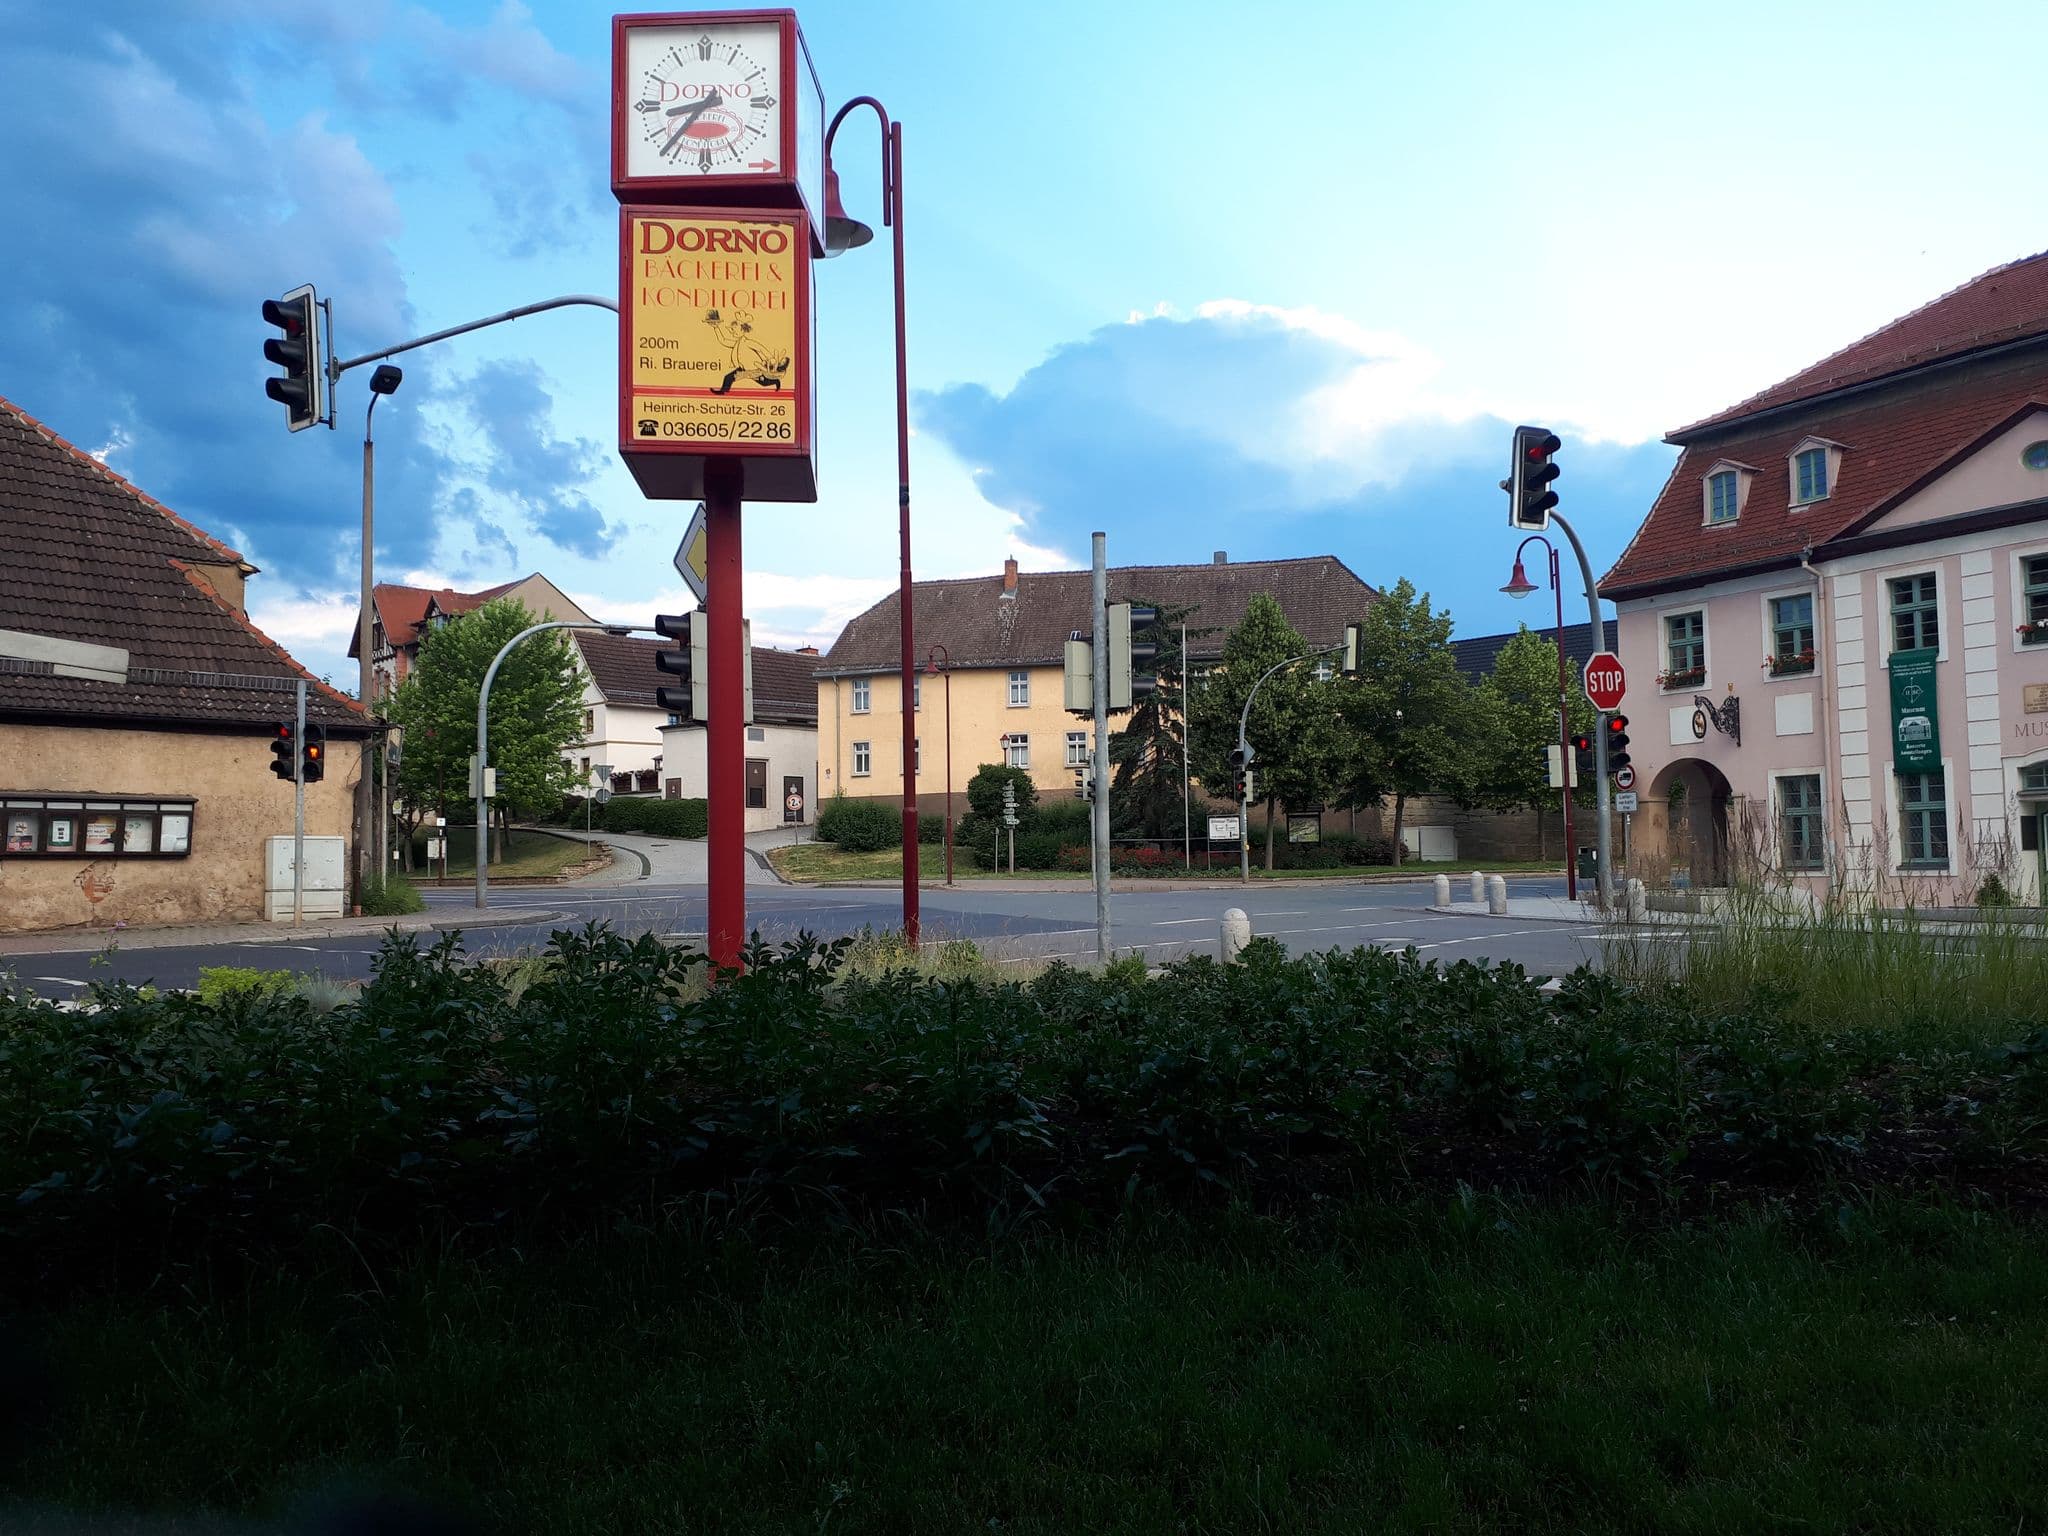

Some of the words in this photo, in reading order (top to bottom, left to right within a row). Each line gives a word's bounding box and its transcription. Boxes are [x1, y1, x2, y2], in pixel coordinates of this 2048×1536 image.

[640, 221, 788, 255] DORNO
[645, 255, 760, 281] BÄCKEREI
[766, 262, 782, 281] &
[642, 287, 786, 310] KONDITOREI
[639, 336, 680, 350] 200m
[639, 356, 657, 369] Ri.
[662, 357, 722, 371] Brauerei
[643, 401, 766, 416] Heinrich-Schütz-Str.
[770, 405, 786, 416] 26
[1590, 671, 1622, 692] STOP
